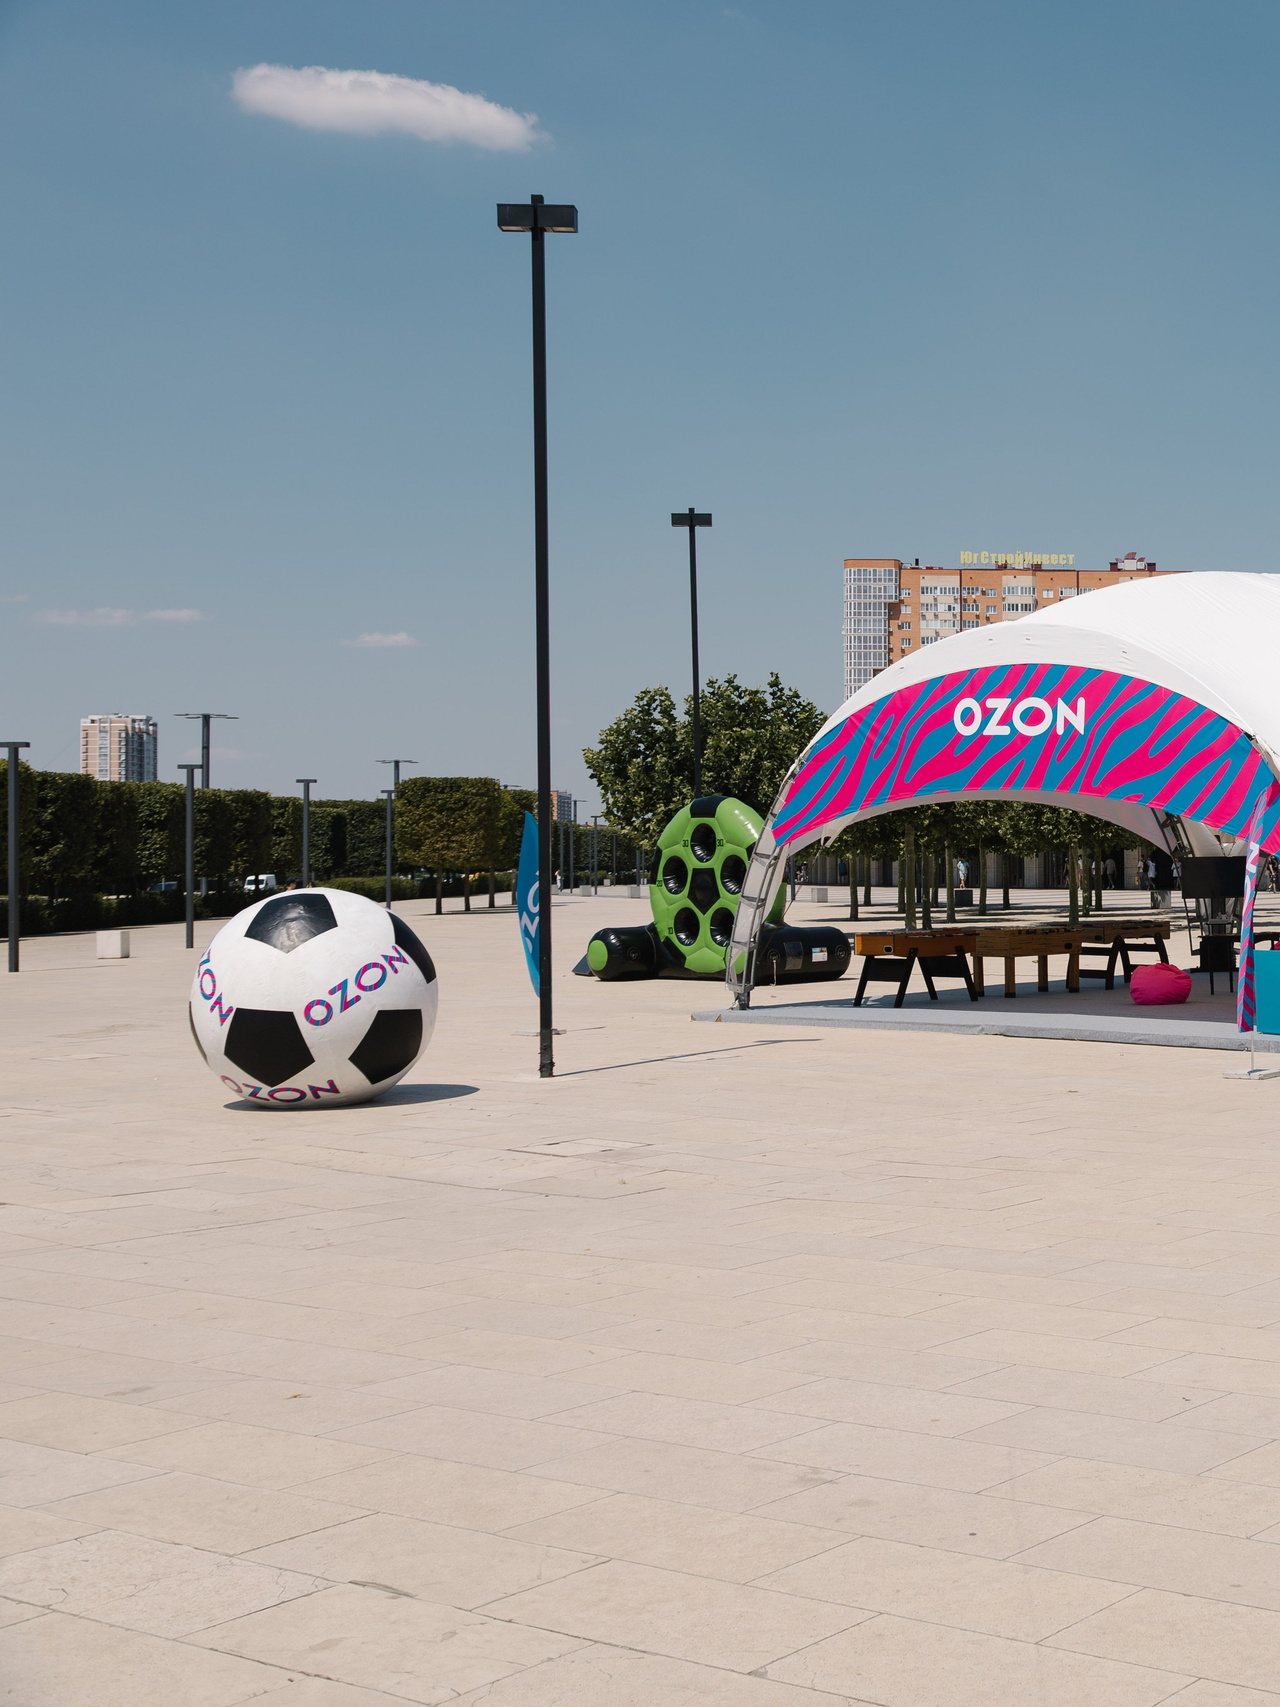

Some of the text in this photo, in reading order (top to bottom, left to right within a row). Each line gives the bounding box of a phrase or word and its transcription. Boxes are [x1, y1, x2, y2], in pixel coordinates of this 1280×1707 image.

[953, 697, 1086, 737] OZON
[682, 839, 689, 848] 30
[717, 839, 724, 847] 30
[668, 926, 673, 935] 10
[304, 945, 409, 1027] OZON
[220, 1075, 341, 1103] OZON
